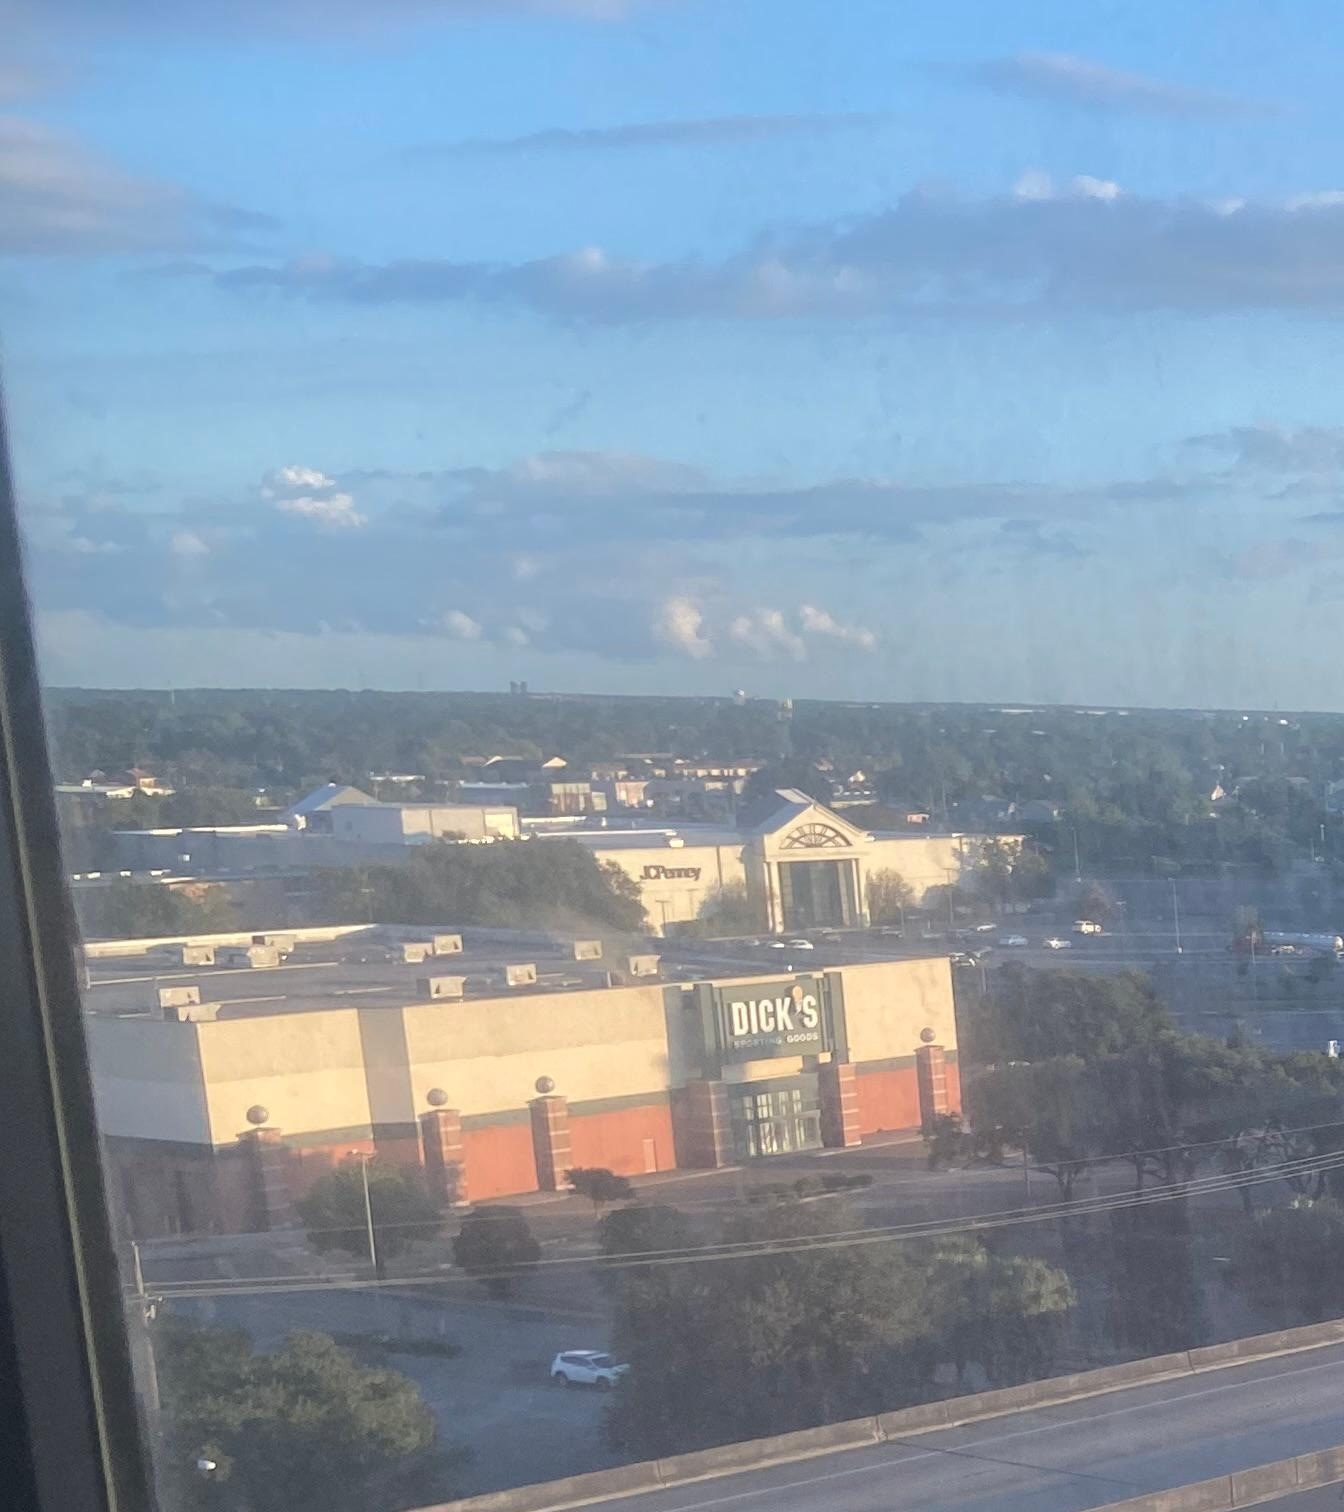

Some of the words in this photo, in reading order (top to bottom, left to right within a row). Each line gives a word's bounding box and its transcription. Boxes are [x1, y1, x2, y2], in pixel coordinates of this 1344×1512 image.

[640, 865, 702, 881] JCPenney
[731, 986, 819, 1036] DICK'S
[786, 1032, 819, 1044] GOODS
